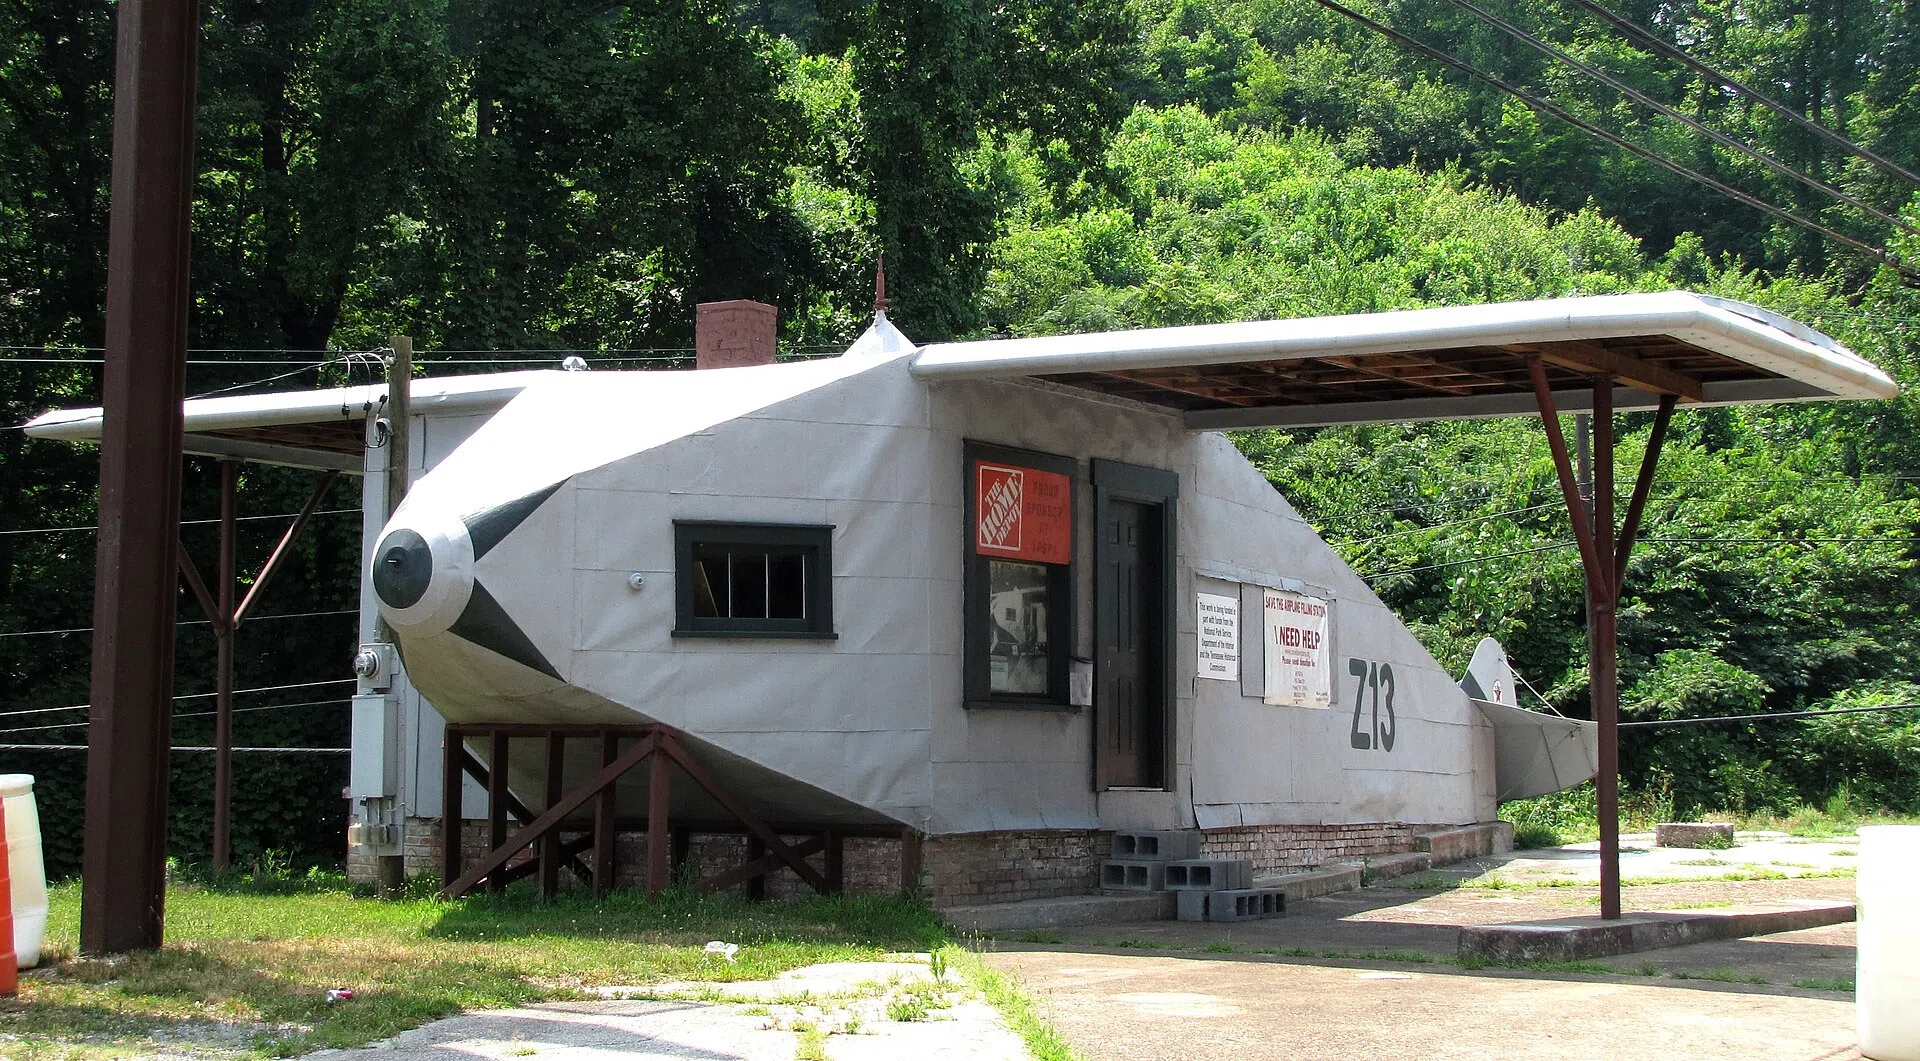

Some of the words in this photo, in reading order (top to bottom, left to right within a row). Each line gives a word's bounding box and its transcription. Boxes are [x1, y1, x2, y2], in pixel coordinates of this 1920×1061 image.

[984, 478, 1002, 507] THE
[980, 471, 1021, 546] HOME
[996, 500, 1020, 546] DEPOT
[1216, 605, 1224, 615] being
[1224, 605, 1233, 615] funded
[1265, 596, 1276, 609] SAVE
[1276, 597, 1284, 611] THE
[1284, 599, 1301, 614] AIRPLANE
[1301, 602, 1313, 616] FILLING
[1313, 604, 1327, 618] STATION
[1204, 626, 1216, 635] National
[1274, 625, 1279, 645] I
[1279, 626, 1301, 648] NEED
[1302, 629, 1321, 650] HELP
[1201, 638, 1217, 648] Department
[1209, 650, 1224, 660] Tennessee
[1281, 655, 1292, 665] Please
[1348, 657, 1396, 753] Z13
